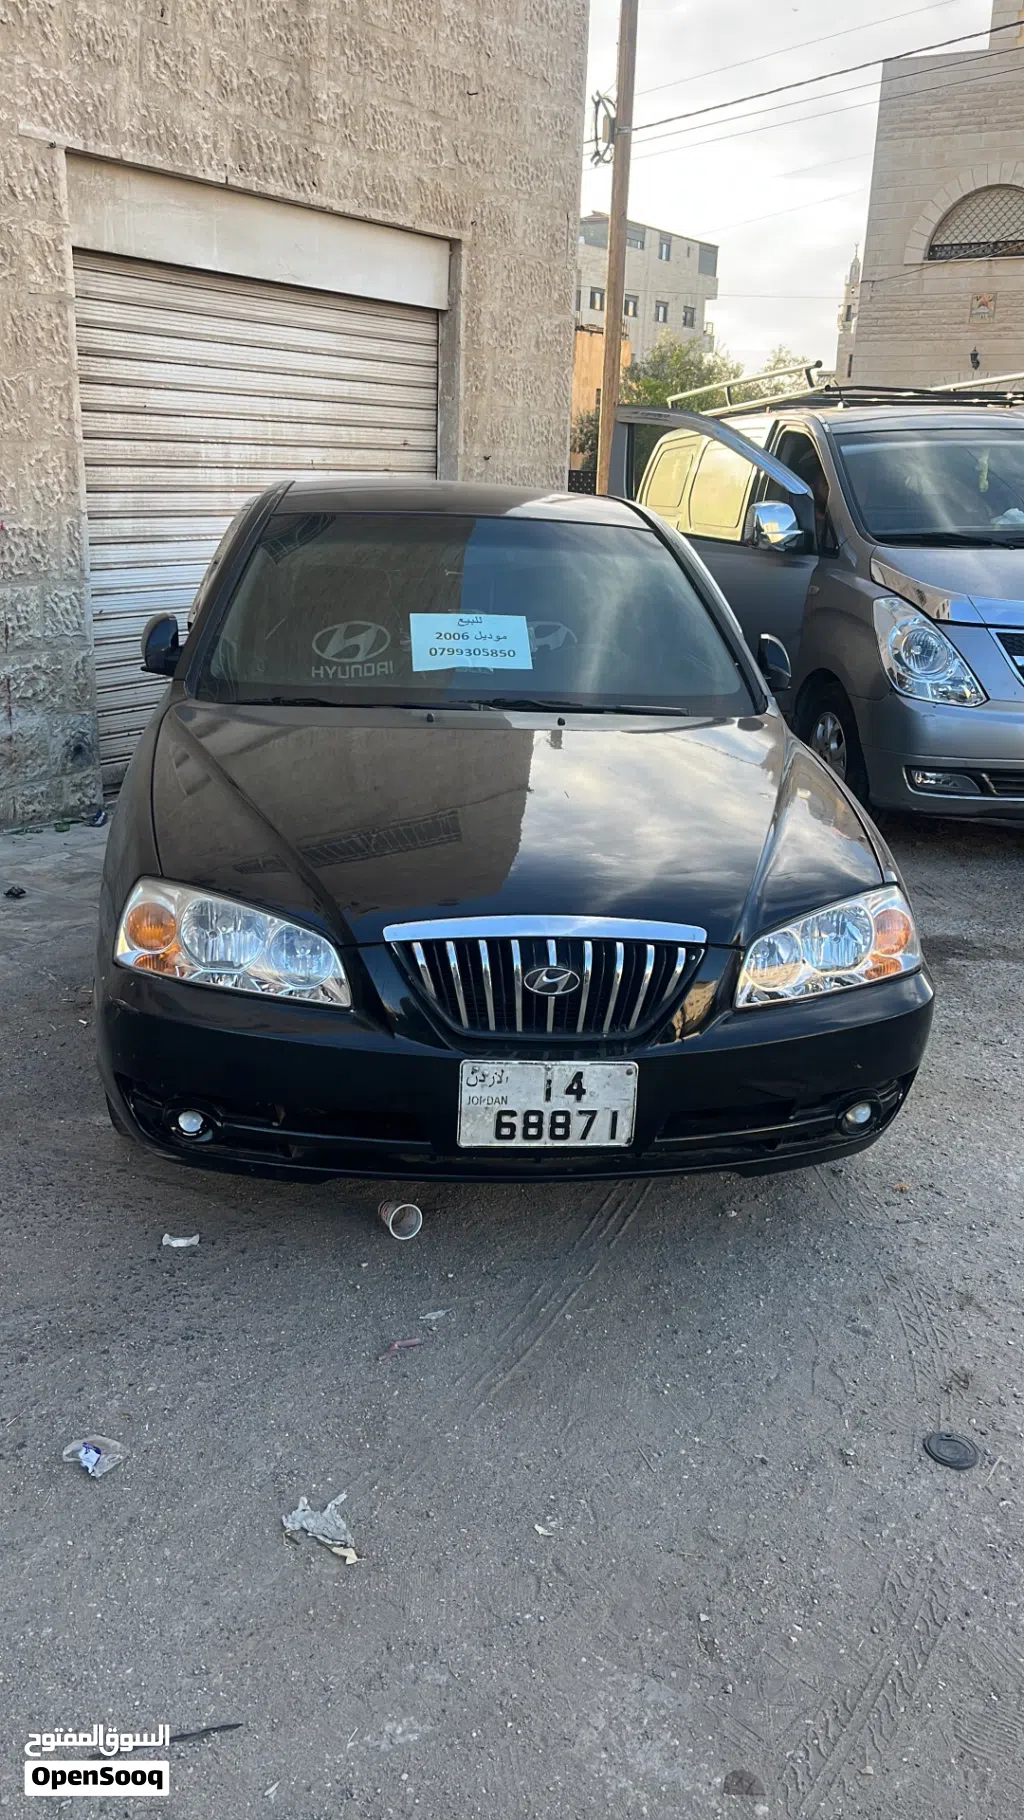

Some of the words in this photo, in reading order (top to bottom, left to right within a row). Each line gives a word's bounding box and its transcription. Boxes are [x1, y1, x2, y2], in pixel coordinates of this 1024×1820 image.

[457, 615, 483, 626] للبيع
[435, 631, 469, 641] 2006
[474, 632, 508, 642] موديل
[429, 647, 516, 659] 0799305850
[311, 660, 394, 679] HYUNDAI
[494, 1109, 619, 1141] 68871
